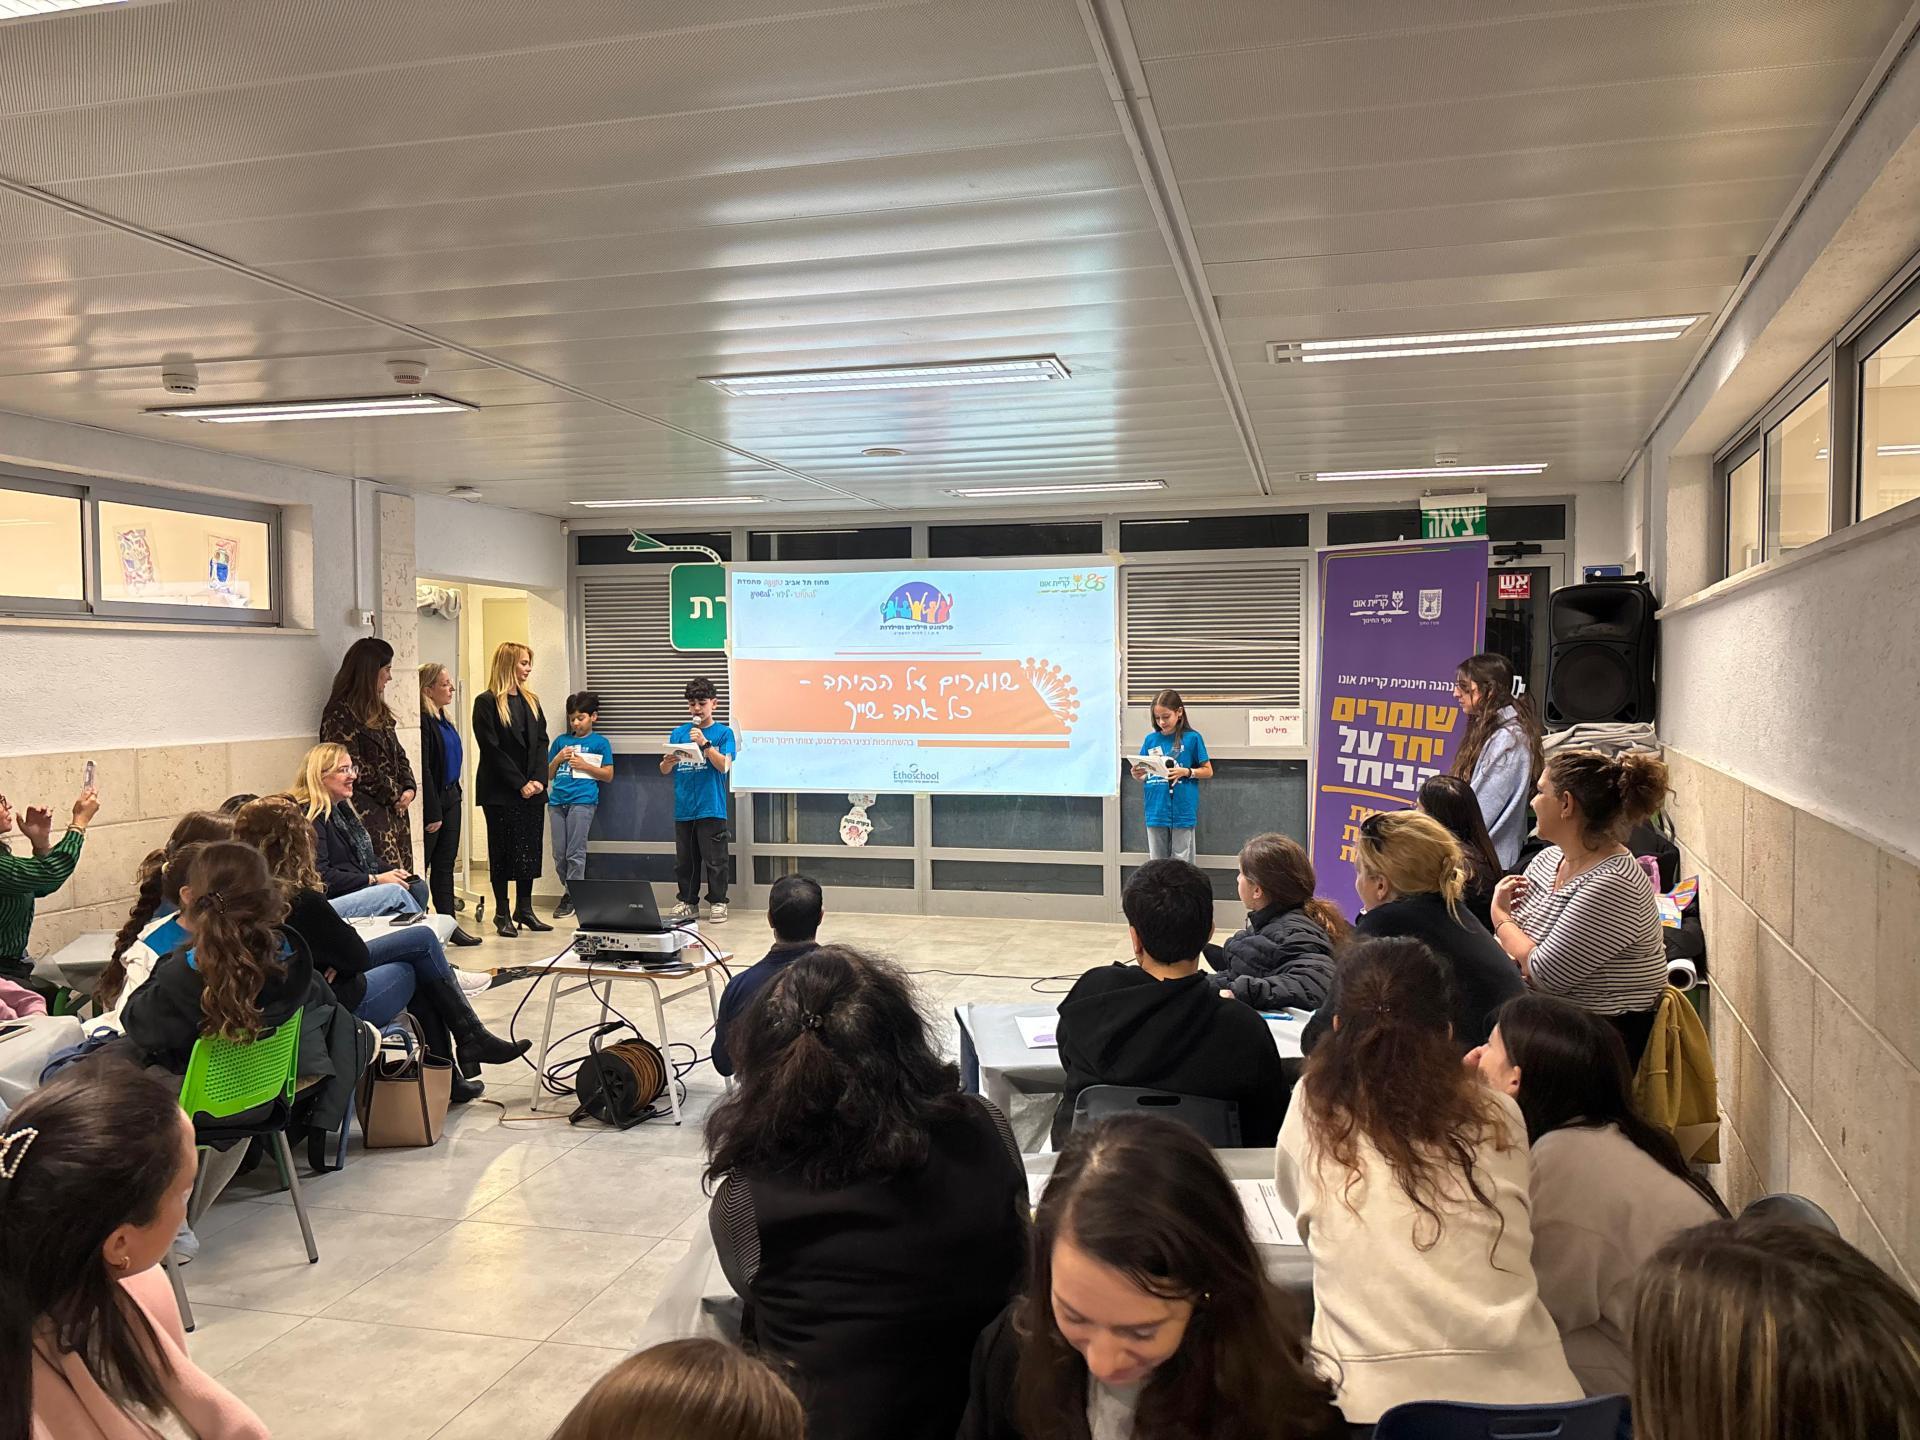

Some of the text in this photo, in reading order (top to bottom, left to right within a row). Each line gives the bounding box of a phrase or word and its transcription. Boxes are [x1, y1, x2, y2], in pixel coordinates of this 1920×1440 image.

[1428, 507, 1480, 538] יציאה
[1500, 575, 1528, 589] אש
[1367, 599, 1389, 609] קריית
[823, 673, 893, 692] הביחד
[906, 666, 928, 692] על
[939, 672, 1020, 696] שומרים
[1338, 674, 1357, 685] אונו
[1359, 675, 1388, 689] קריית
[1390, 678, 1426, 690] חינוכית
[844, 696, 973, 731] כל אחד שייך
[1331, 696, 1459, 732] שומרים
[1338, 725, 1445, 763] יחד על
[893, 770, 939, 780] Ethoschool
